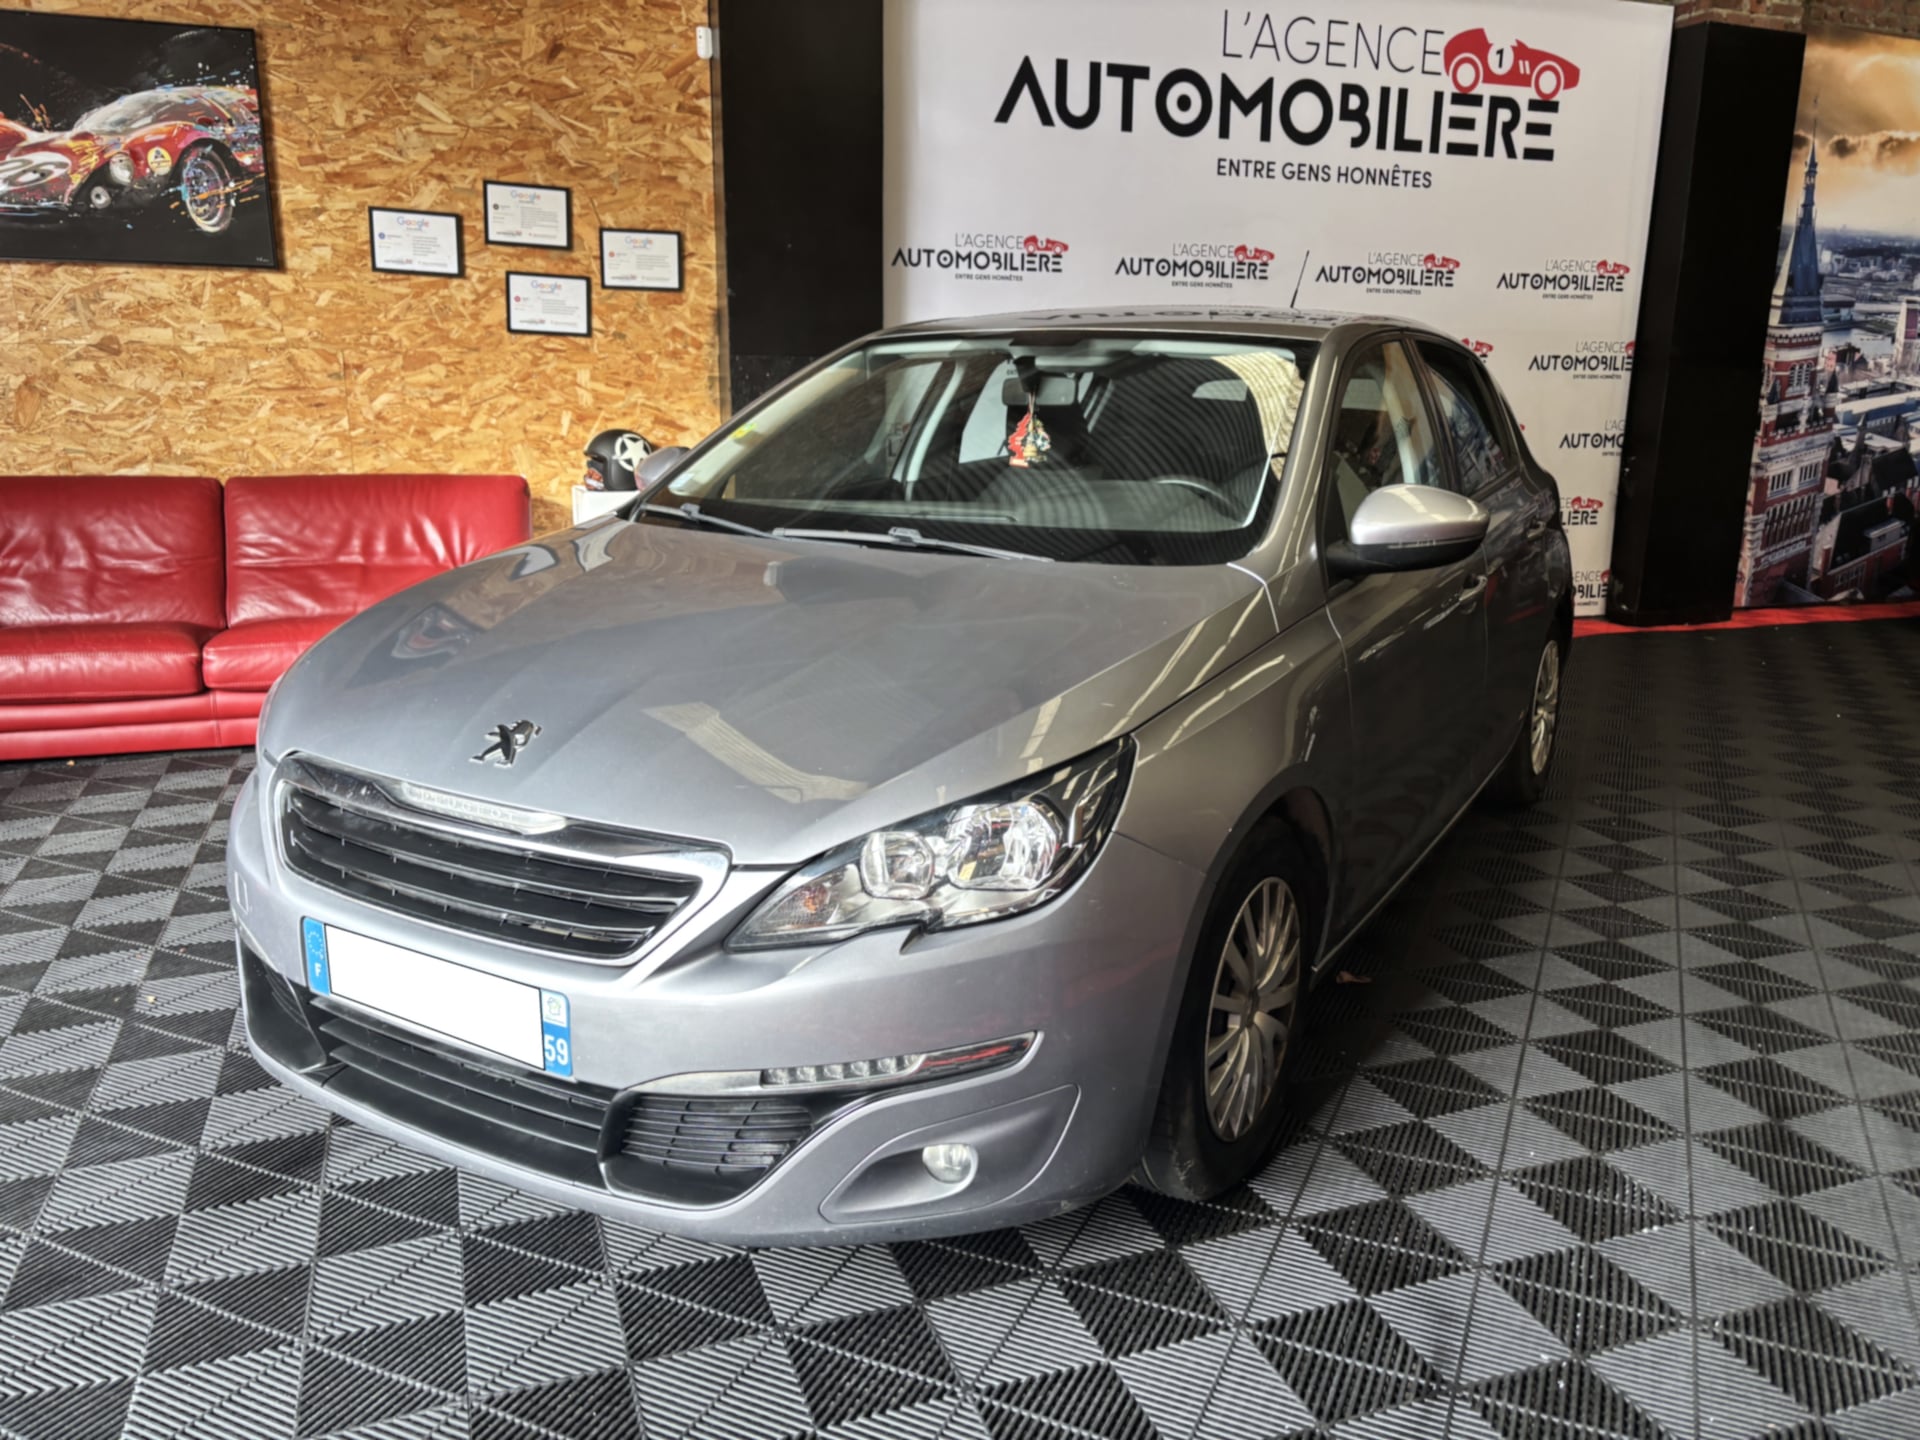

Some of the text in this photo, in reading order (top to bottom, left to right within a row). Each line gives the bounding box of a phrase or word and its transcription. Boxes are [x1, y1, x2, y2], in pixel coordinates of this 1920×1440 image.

[1222, 9, 1445, 76] L'AGENCE
[1216, 158, 1433, 189] ENTRE GENS HONNÊTES
[396, 215, 430, 230] Google
[954, 233, 1024, 250] L'AGENCE
[1172, 243, 1234, 259] L'AGENCE
[1367, 251, 1424, 267] L'AGENCE
[530, 279, 562, 293] Google
[314, 962, 322, 977] F
[544, 1033, 569, 1066] 59
